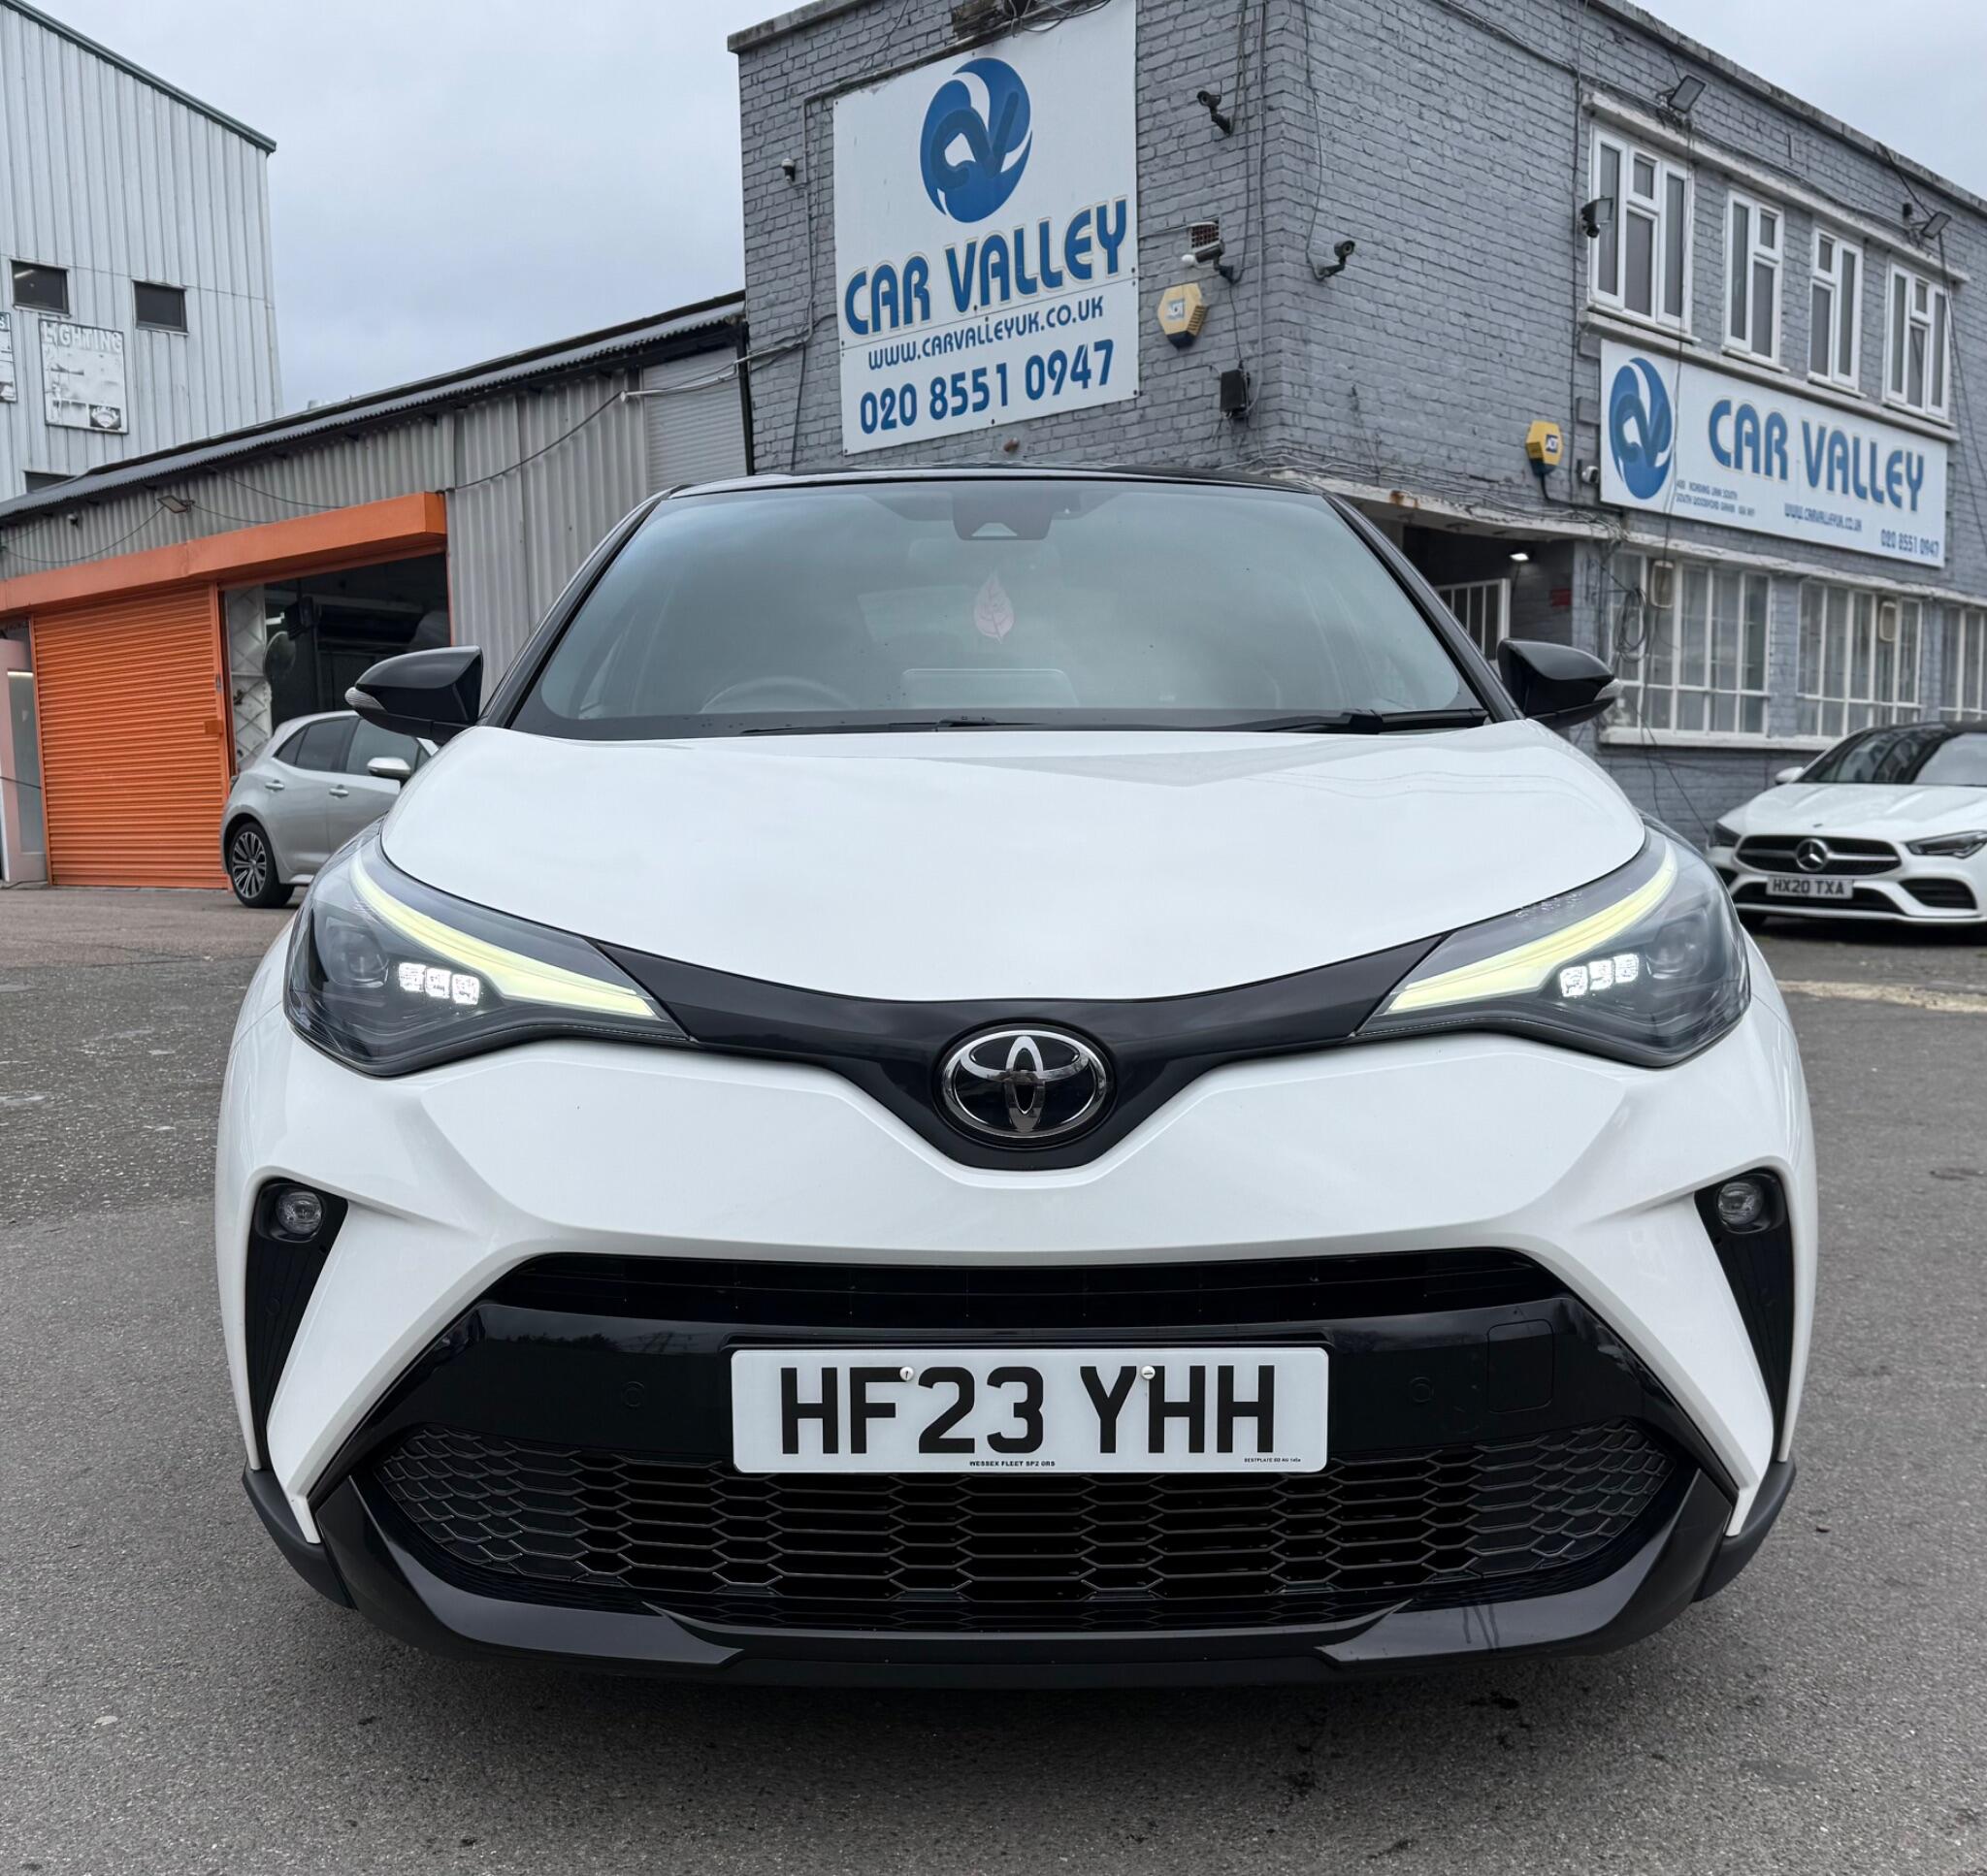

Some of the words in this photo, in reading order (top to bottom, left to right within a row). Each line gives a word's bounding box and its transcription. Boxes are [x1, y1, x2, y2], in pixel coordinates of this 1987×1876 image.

[844, 254, 931, 337] CAR
[944, 198, 1128, 314] VALLEY
[42, 320, 123, 353] LIGHTING
[860, 382, 918, 435] 020
[928, 362, 1009, 420] 8551
[1025, 339, 1115, 401] 0947
[1708, 399, 1789, 481] CAR
[1801, 419, 1925, 512] VALLEY
[1880, 529, 1897, 549] 020
[1899, 533, 1918, 554] 8551
[1919, 537, 1939, 558] 0947
[1773, 878, 1811, 893] HX20
[1814, 880, 1845, 895] TXA
[780, 1365, 1044, 1455] HF23
[1080, 1364, 1276, 1454] YHH
